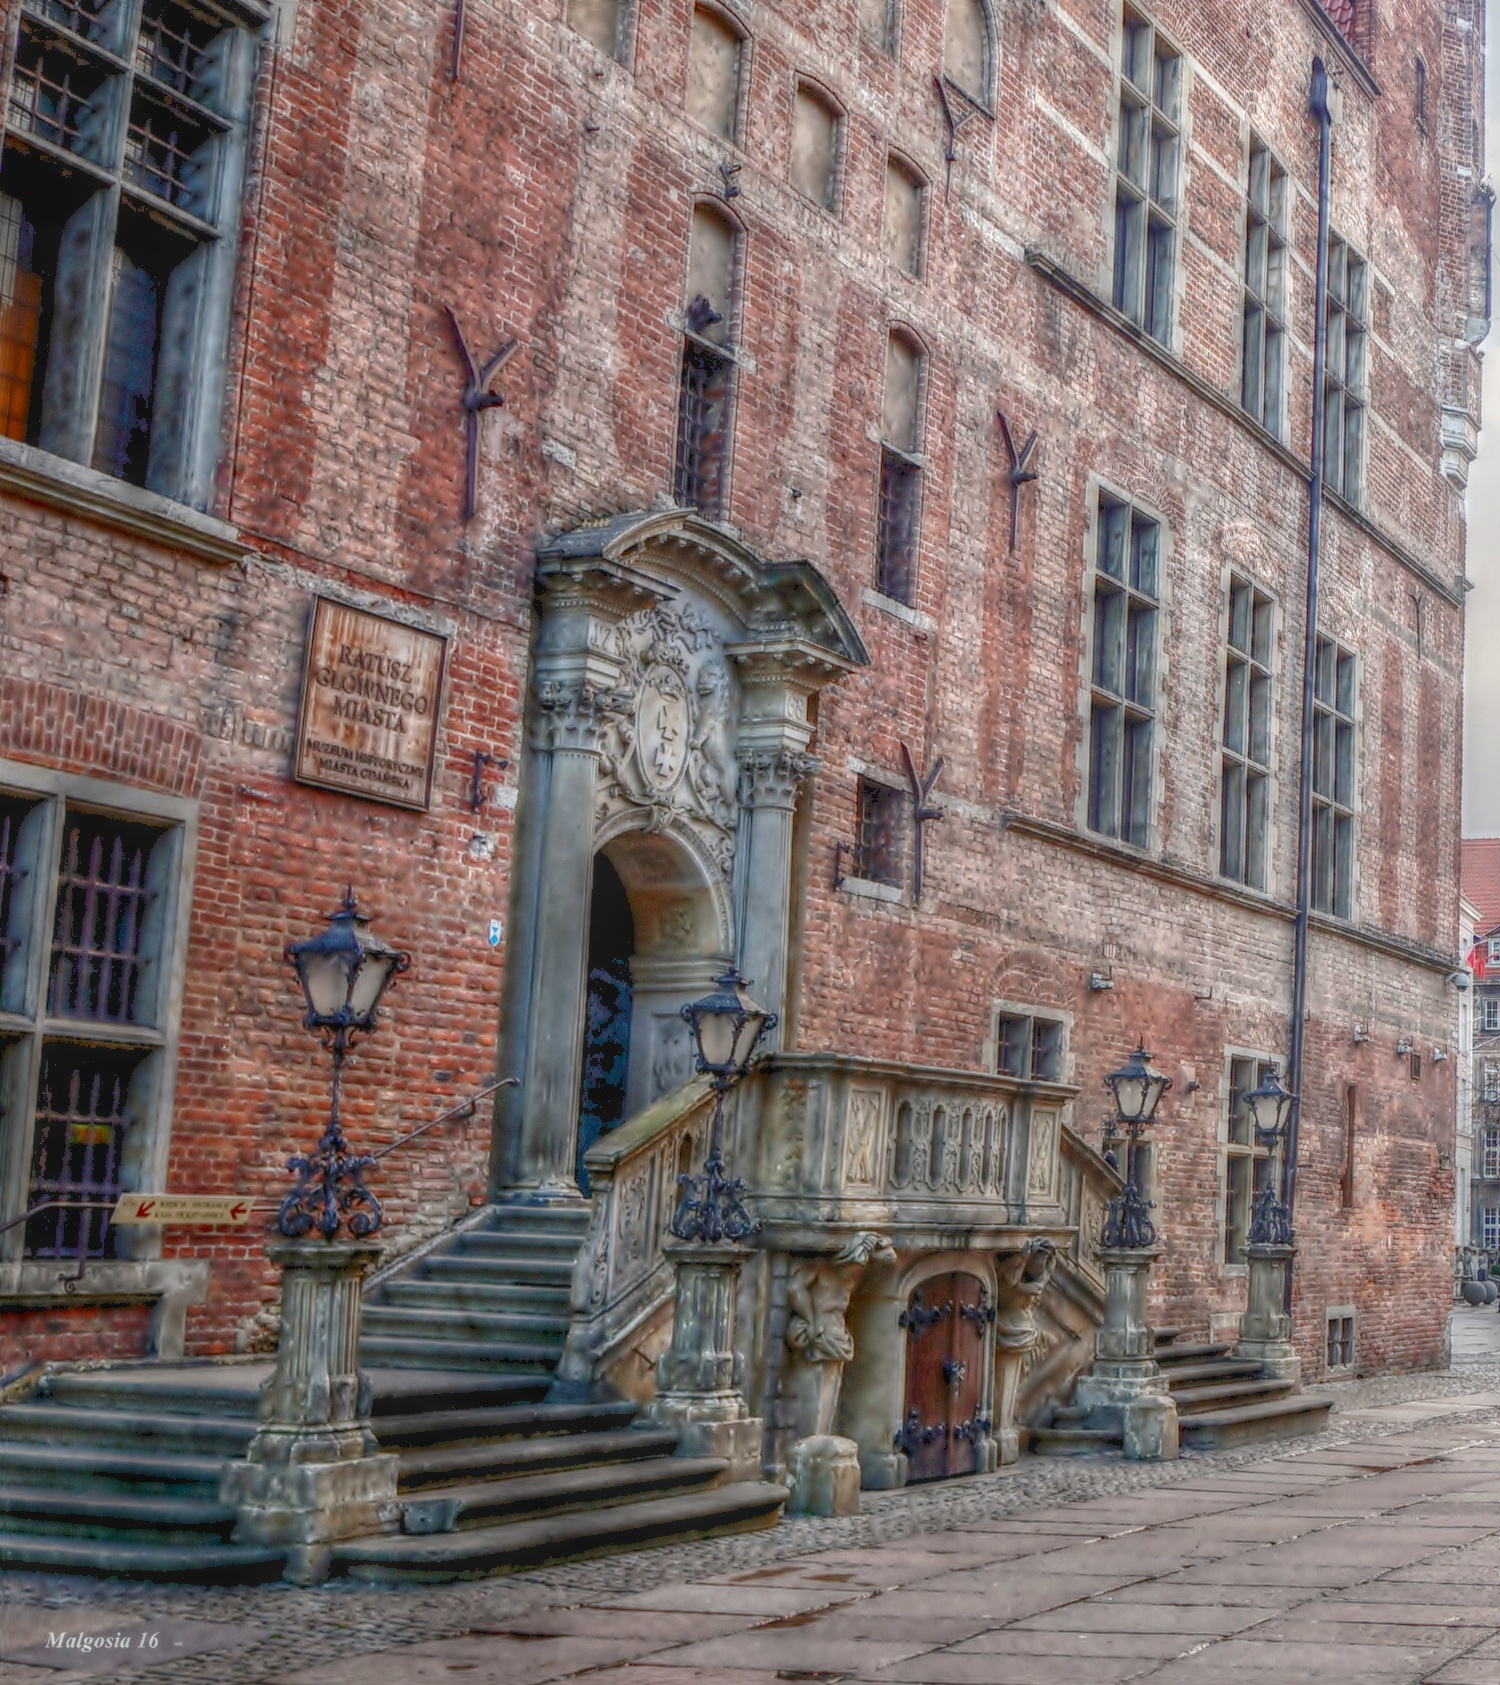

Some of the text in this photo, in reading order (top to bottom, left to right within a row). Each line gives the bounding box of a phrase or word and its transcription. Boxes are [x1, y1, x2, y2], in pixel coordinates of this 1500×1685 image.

[339, 644, 413, 684] RATUSZ
[333, 695, 405, 734] MIASTA
[306, 738, 353, 761] MUZEUM
[318, 757, 410, 790] MIASTA GDAŃSKA
